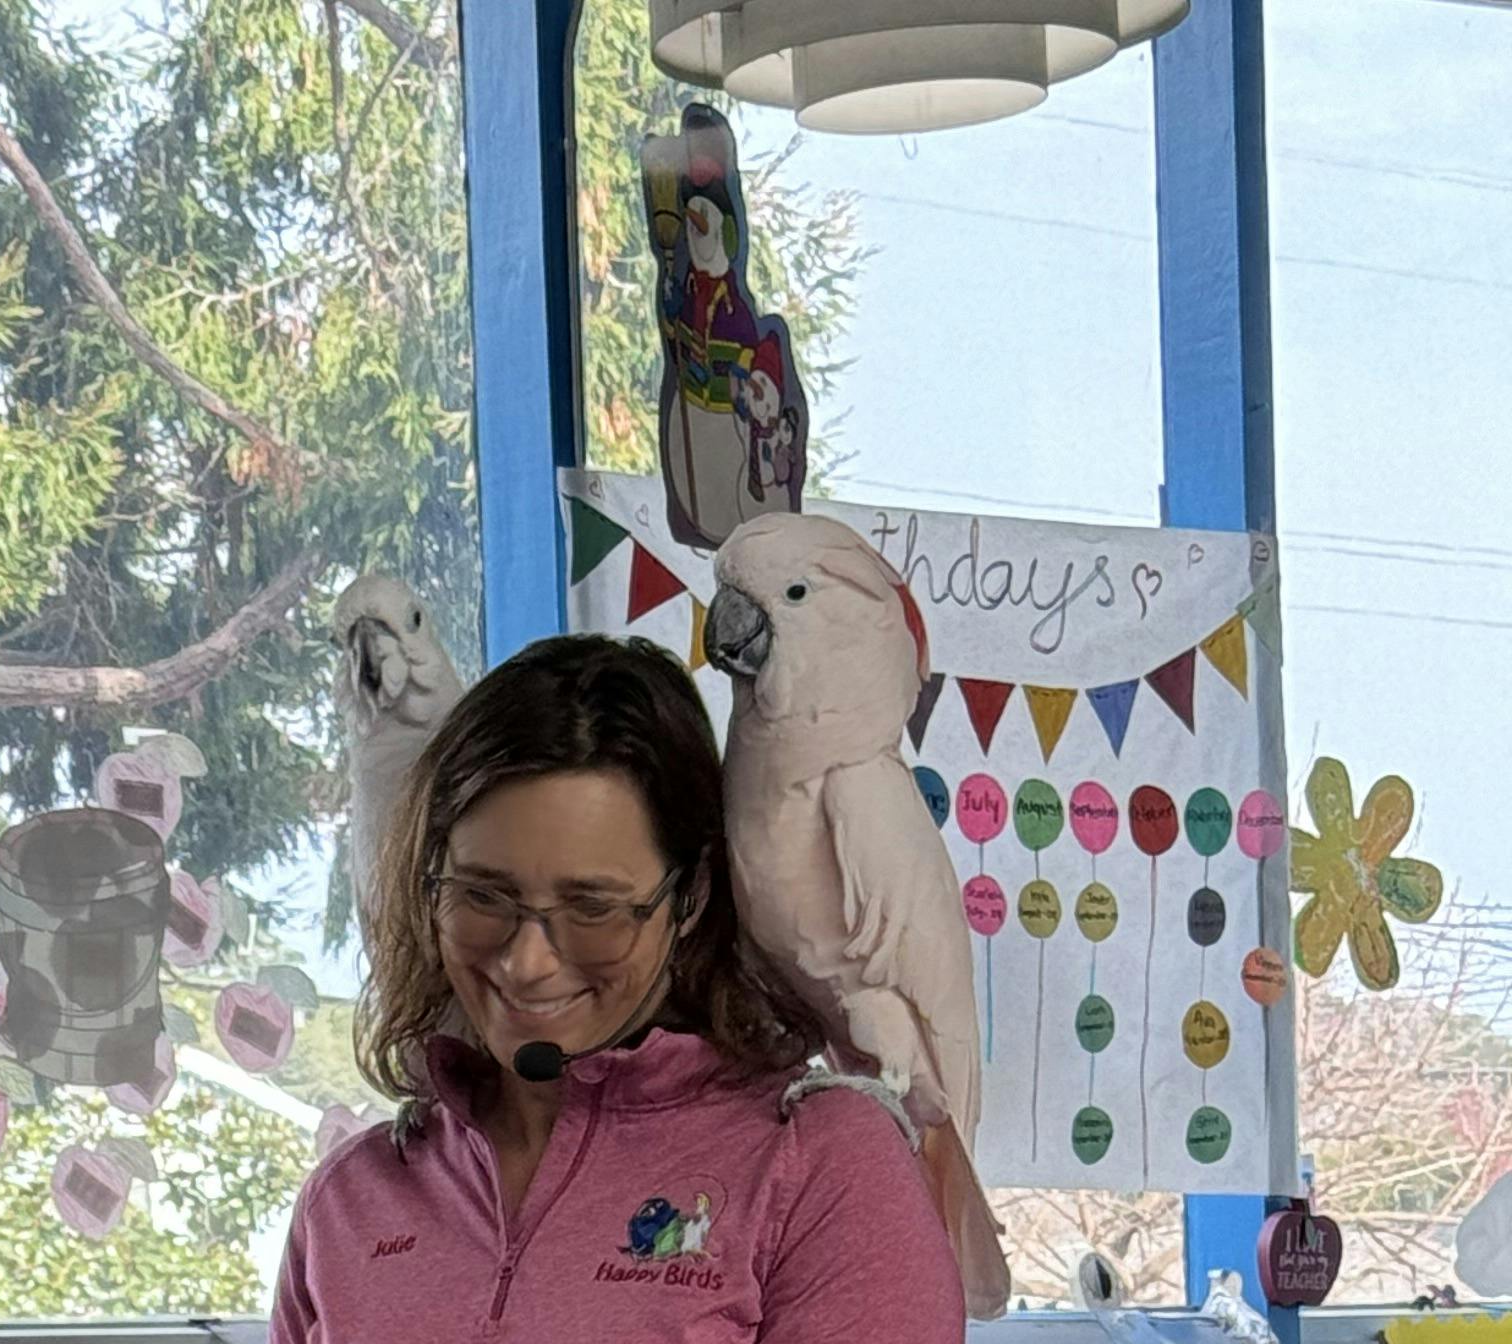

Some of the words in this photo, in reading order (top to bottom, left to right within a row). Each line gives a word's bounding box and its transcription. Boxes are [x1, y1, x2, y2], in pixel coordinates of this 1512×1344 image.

[872, 512, 1116, 654] thdays
[961, 789, 1000, 825] July
[1016, 797, 1063, 821] August
[370, 1234, 417, 1259] Julie
[592, 1260, 663, 1284] Happy
[663, 1262, 725, 1291] Birds
